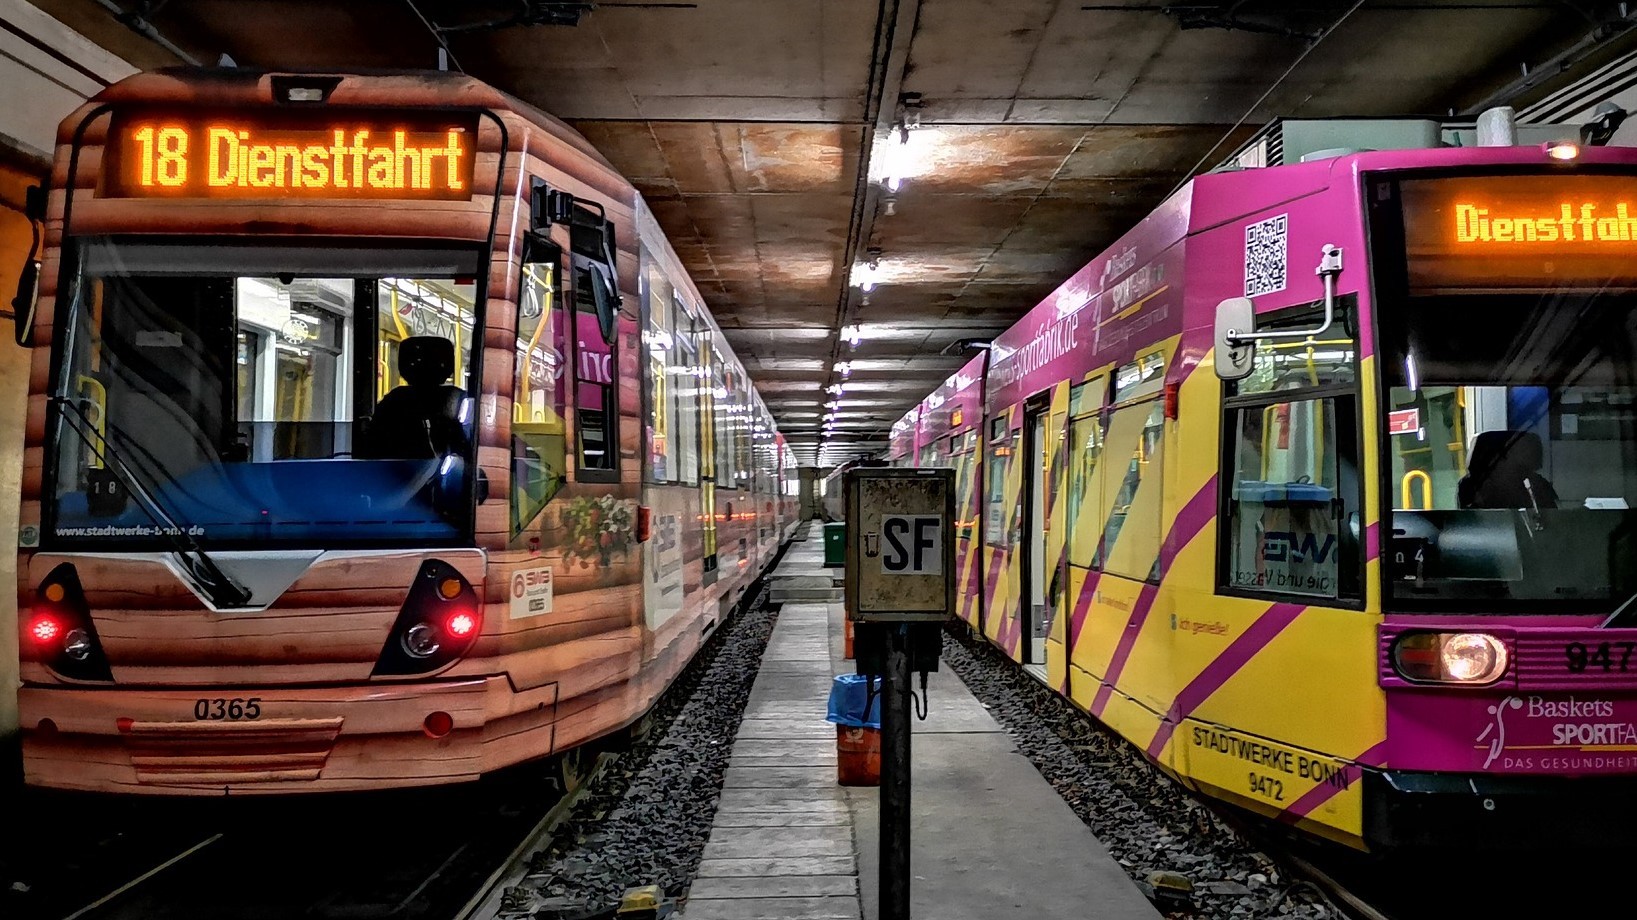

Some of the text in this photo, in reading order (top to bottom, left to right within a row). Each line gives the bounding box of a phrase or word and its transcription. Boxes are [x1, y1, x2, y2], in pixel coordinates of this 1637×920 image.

[136, 128, 463, 189] 18 Dienstfahrt
[884, 518, 940, 571] SF
[513, 574, 525, 598] 6
[1565, 642, 1636, 673] 947
[194, 698, 262, 720] 0365
[1527, 696, 1613, 717] Baskets
[1193, 727, 1349, 791] STADTWERKE BONN
[1504, 757, 1533, 769] DAS
[1249, 772, 1284, 801] 9472
